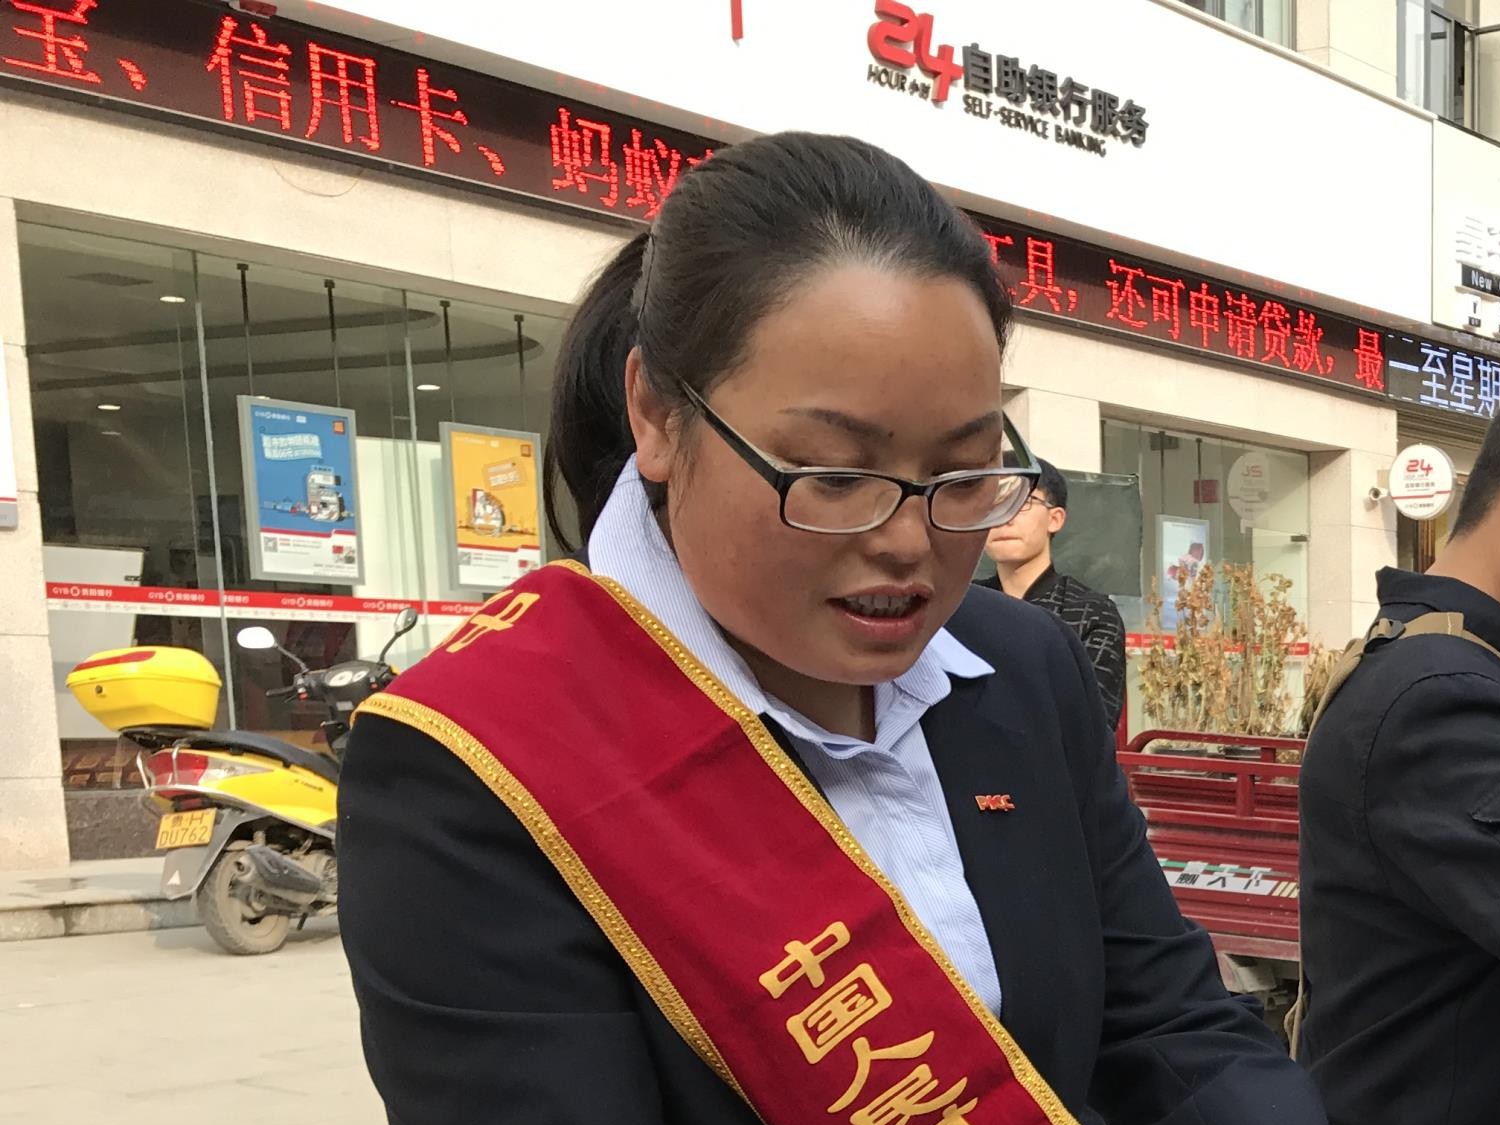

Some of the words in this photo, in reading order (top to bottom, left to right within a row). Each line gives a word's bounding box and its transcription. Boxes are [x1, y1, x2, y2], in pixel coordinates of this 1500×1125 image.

[867, 0, 964, 104] 24
[867, 64, 906, 93] HOUR
[962, 43, 1149, 147] 自助银行服务
[0, 0, 713, 219] 宝、信用卡、蚂蚁
[963, 94, 1049, 140] SELF-SERVICE
[1055, 123, 1106, 158] BANKING
[1471, 270, 1492, 291] New
[1406, 459, 1433, 476] 24
[159, 825, 209, 846] DU762
